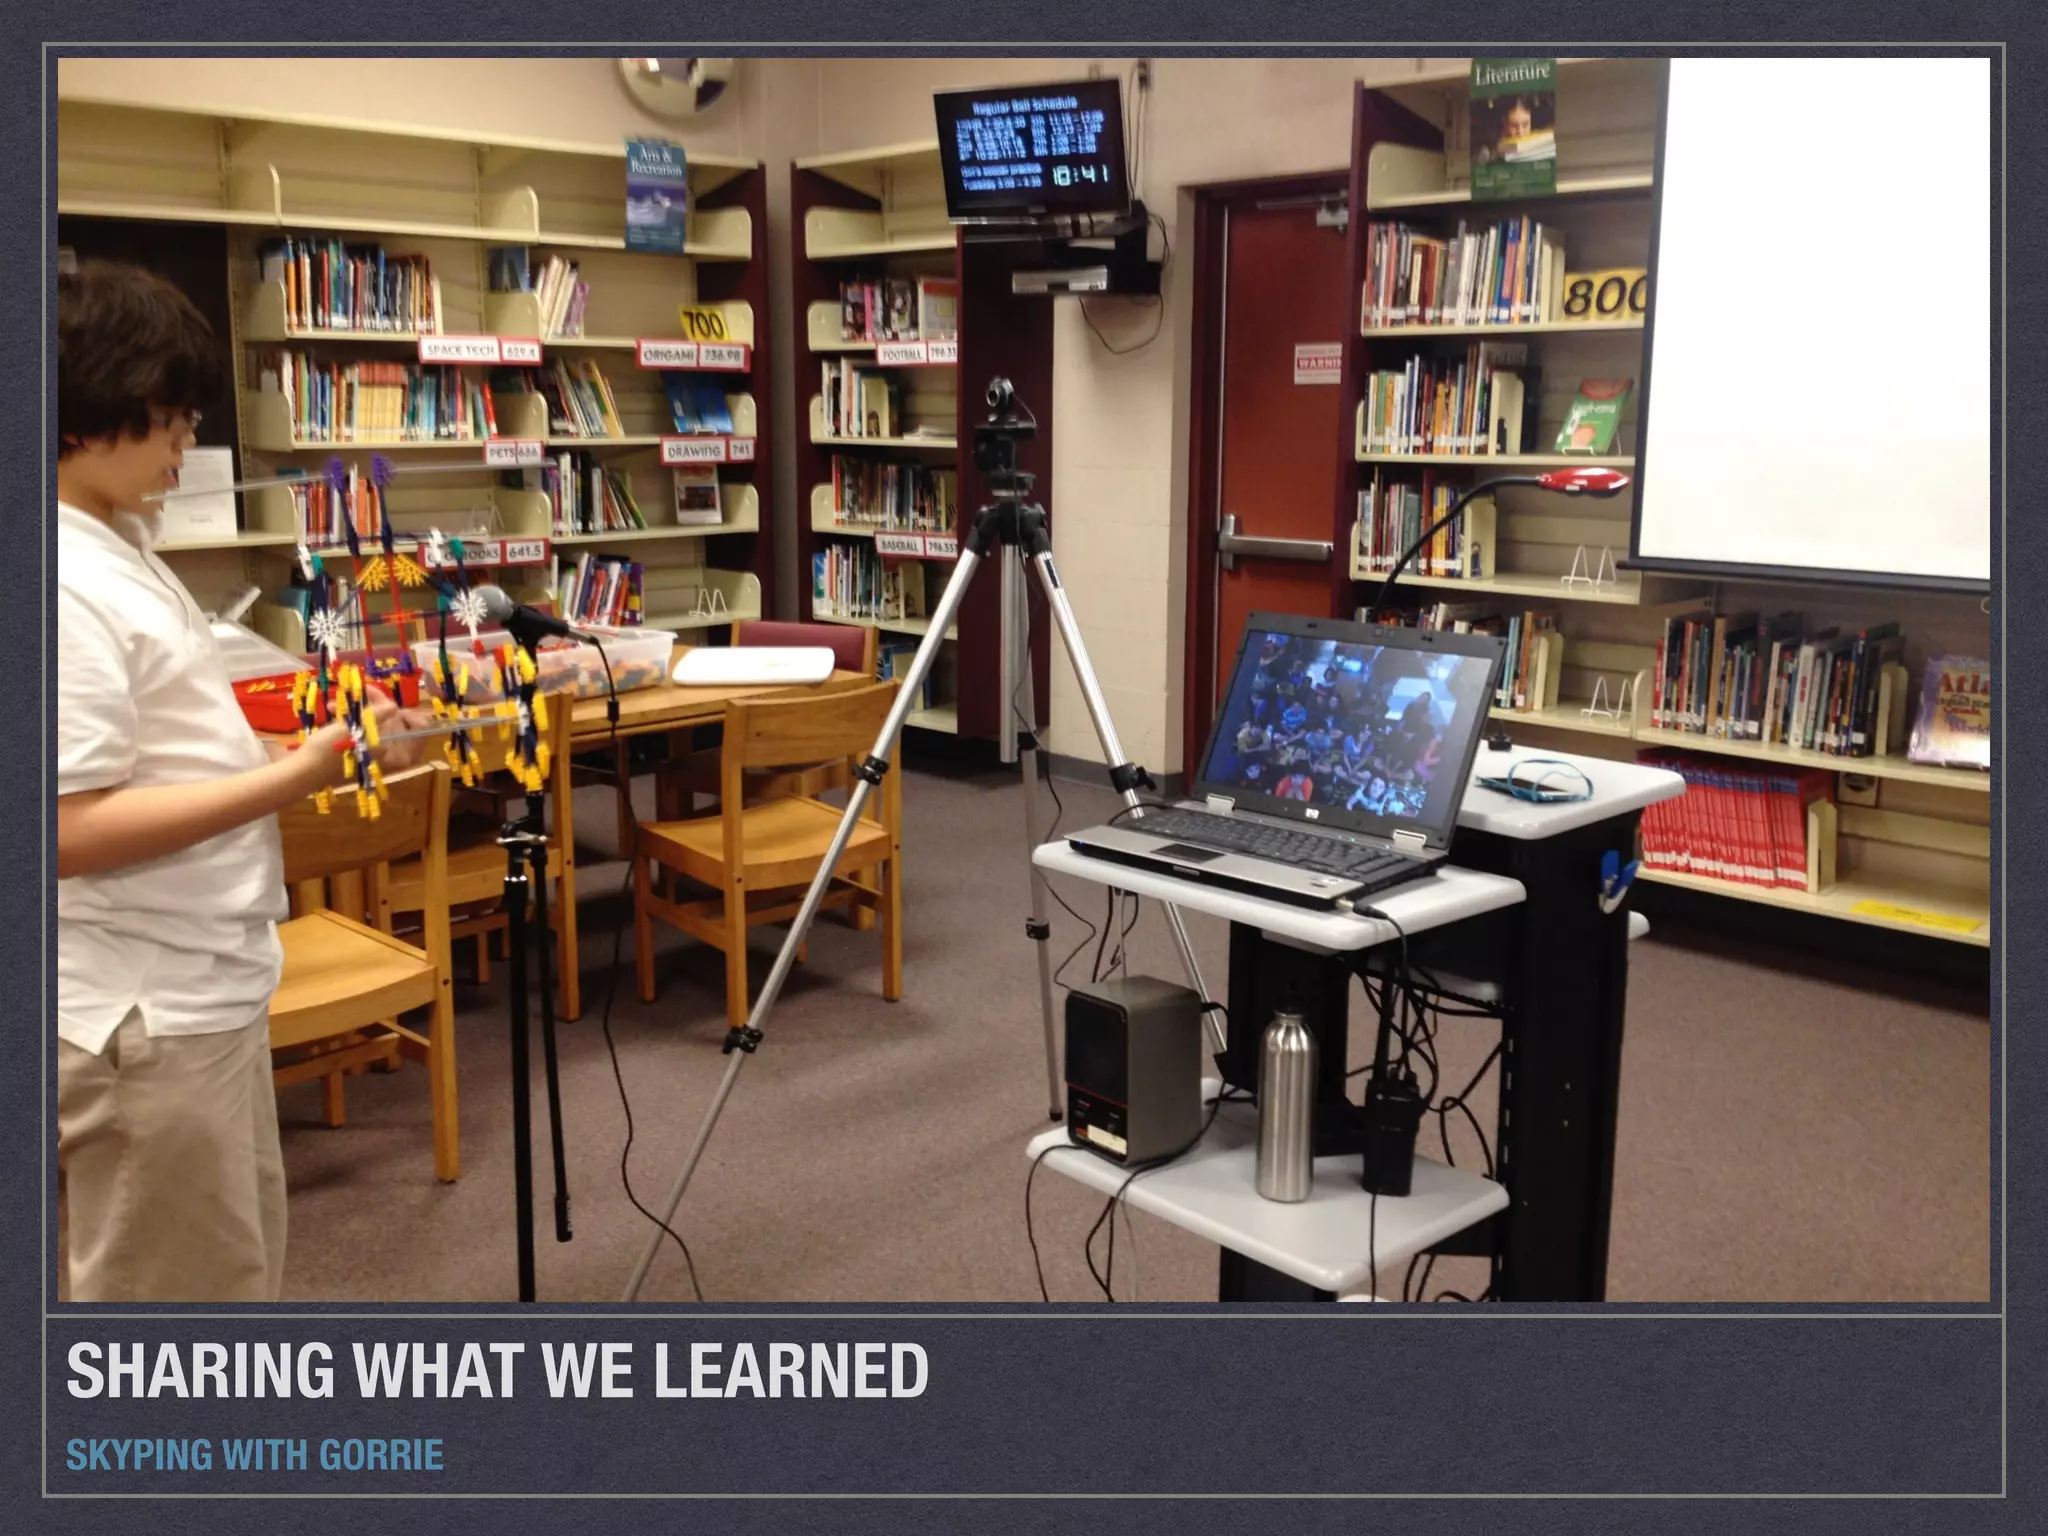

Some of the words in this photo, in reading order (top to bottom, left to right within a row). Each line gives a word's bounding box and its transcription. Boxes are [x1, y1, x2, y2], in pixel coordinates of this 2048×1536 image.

[1476, 63, 1551, 86] Literature
[639, 144, 660, 161] Arts
[630, 157, 683, 177] Recreation
[1053, 164, 1108, 187] 10:41
[682, 311, 725, 341] 700
[427, 344, 462, 356] SPACE
[466, 345, 495, 357] TECH
[644, 349, 695, 362] ORIGAMI
[882, 348, 922, 361] FOOTBALL
[490, 449, 514, 458] PETS
[668, 446, 720, 458] DRAWING
[732, 444, 750, 455] 741
[508, 547, 541, 558] 641.5
[881, 541, 919, 553] BASEBALL
